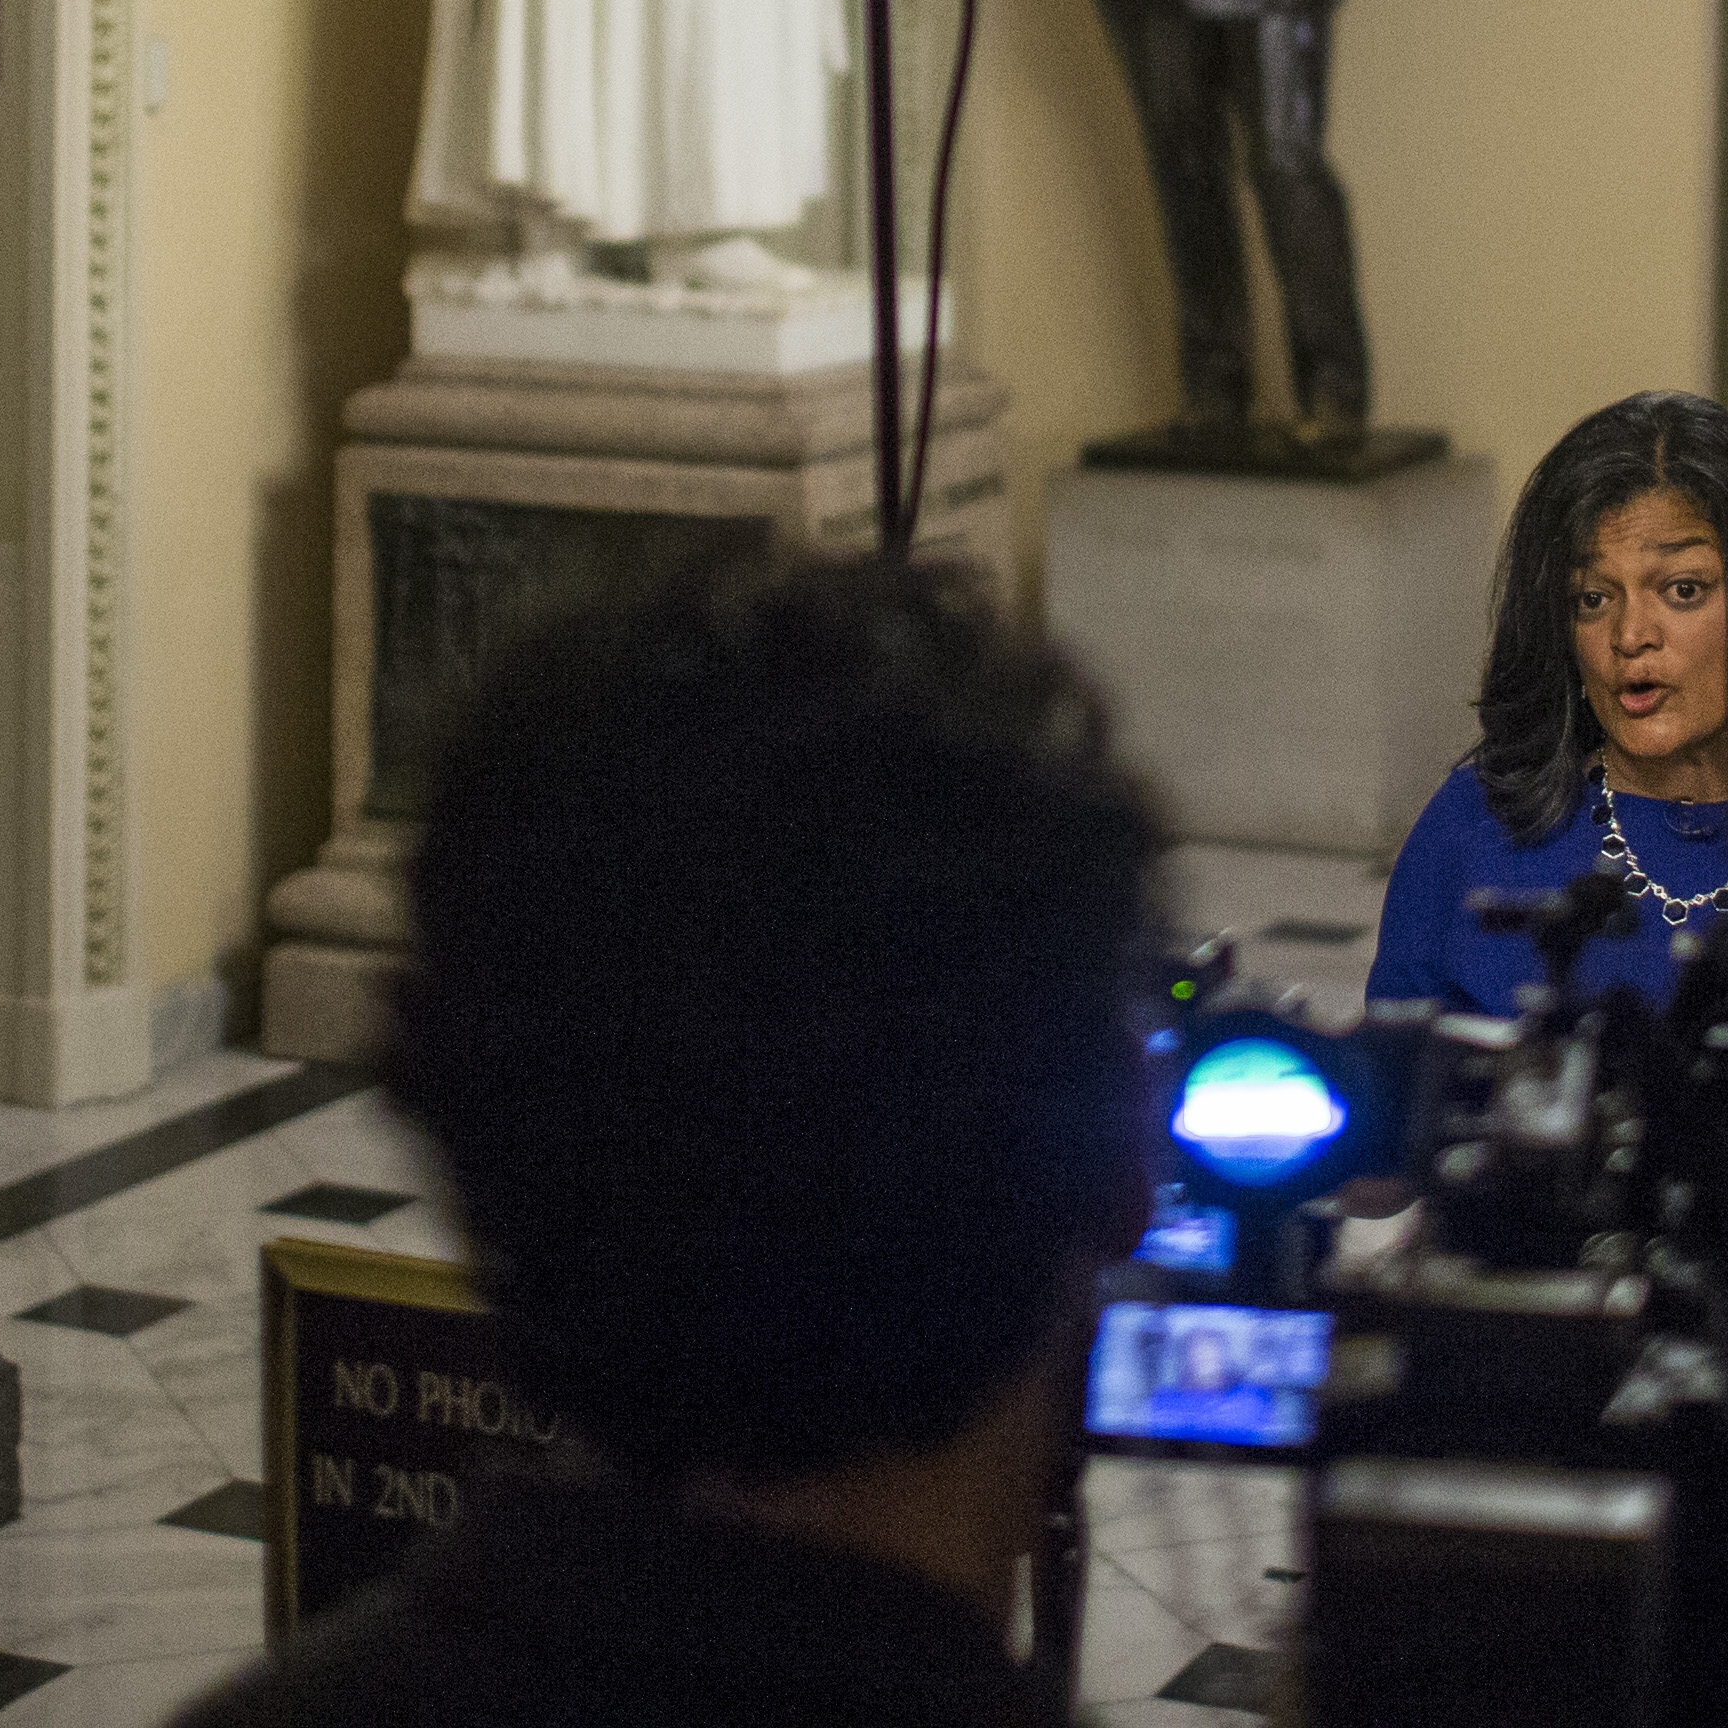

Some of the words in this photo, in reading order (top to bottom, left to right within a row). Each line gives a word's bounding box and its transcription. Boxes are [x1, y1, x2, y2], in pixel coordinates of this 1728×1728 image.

[333, 1358, 399, 1417] NO
[312, 1454, 356, 1507] IN
[374, 1462, 460, 1529] 2ND
